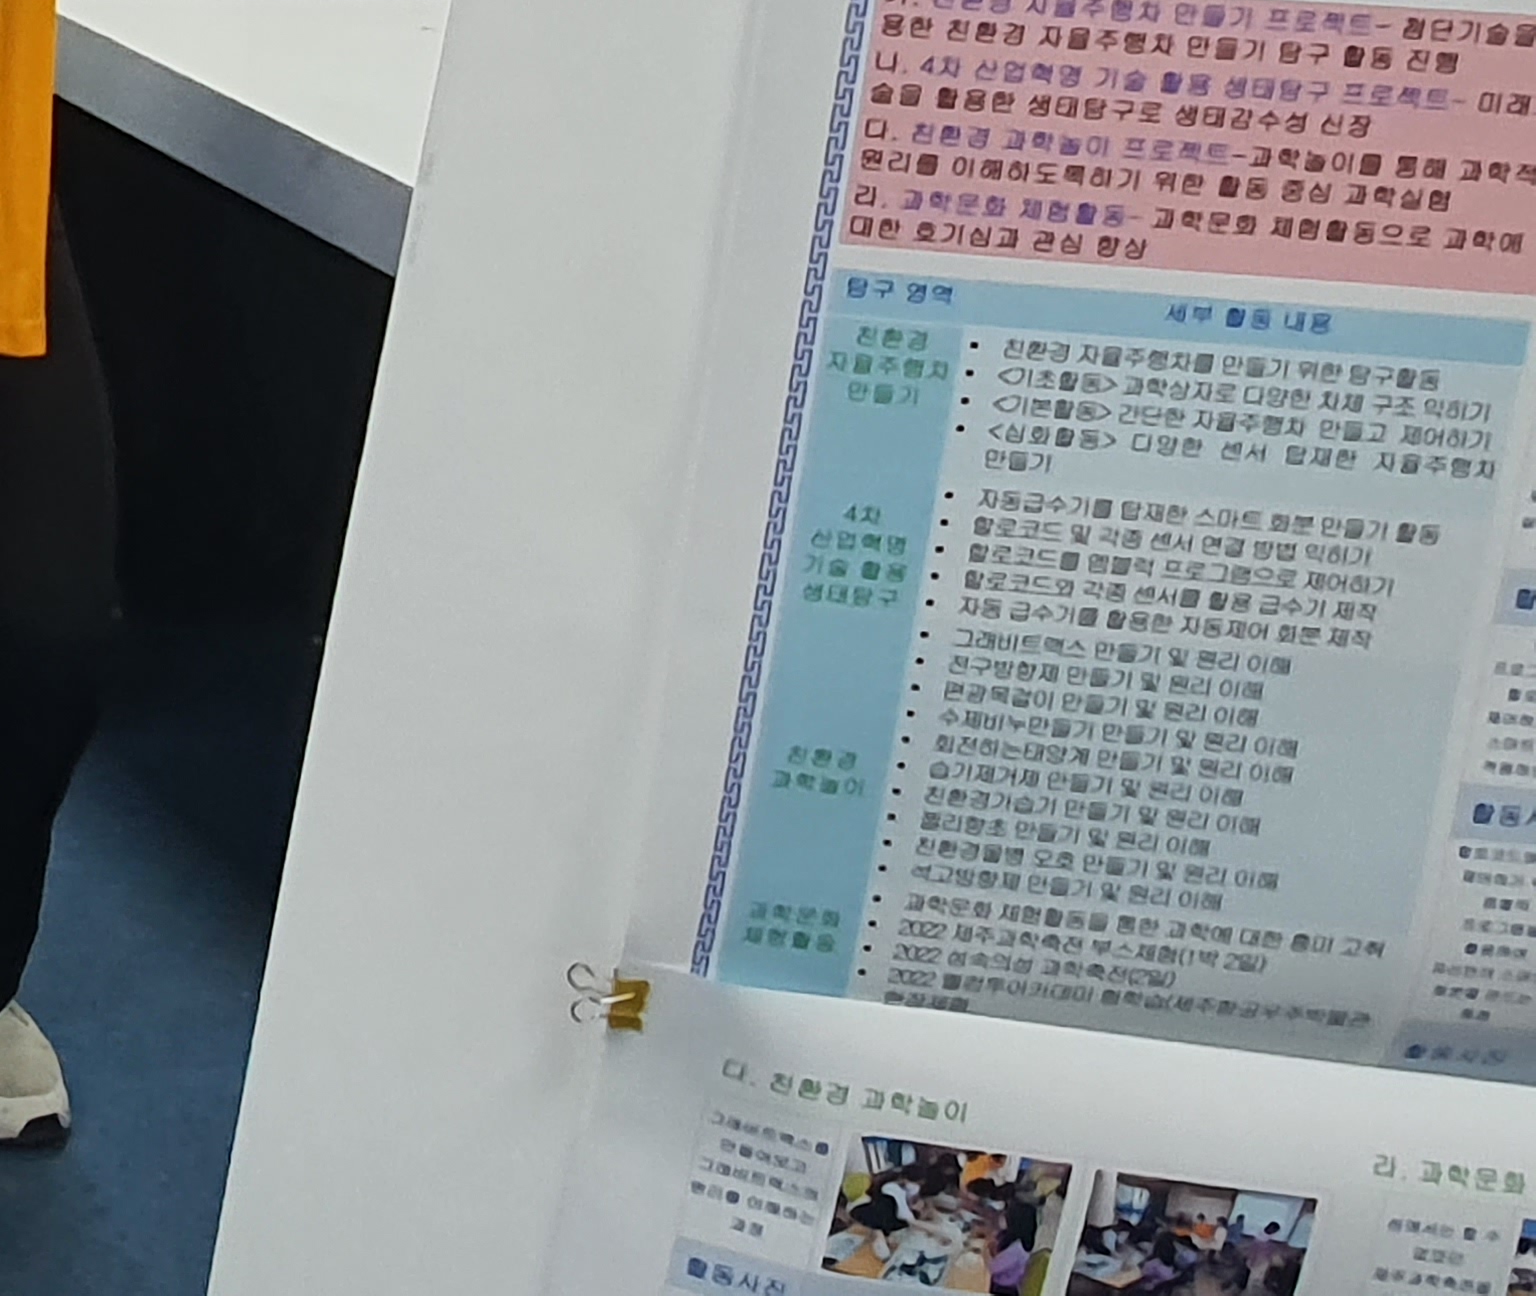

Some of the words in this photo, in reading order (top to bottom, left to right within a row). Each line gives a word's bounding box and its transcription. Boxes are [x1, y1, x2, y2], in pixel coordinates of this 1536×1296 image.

[881, 14, 933, 39] 용한
[947, 19, 1025, 46] 친환경
[1039, 25, 1174, 55] 자율주행차
[1187, 35, 1265, 62] 만들기
[1279, 41, 1329, 65] 탐구
[1344, 45, 1393, 70] 활동
[1407, 50, 1458, 74] 진행
[850, 215, 900, 239] 대한
[916, 221, 1019, 249] 호기심과
[1032, 230, 1083, 255] 관심
[1097, 235, 1147, 260] 향상
[847, 277, 894, 298] 탐구
[907, 283, 953, 304] 영역
[1164, 304, 1212, 323] 세부
[1226, 308, 1271, 330] 활동
[1284, 311, 1332, 334] 내용
[856, 326, 927, 351] 친환경
[1003, 338, 1070, 363] 친환경
[1223, 356, 1290, 379] 만들기
[1298, 361, 1342, 383] 위한
